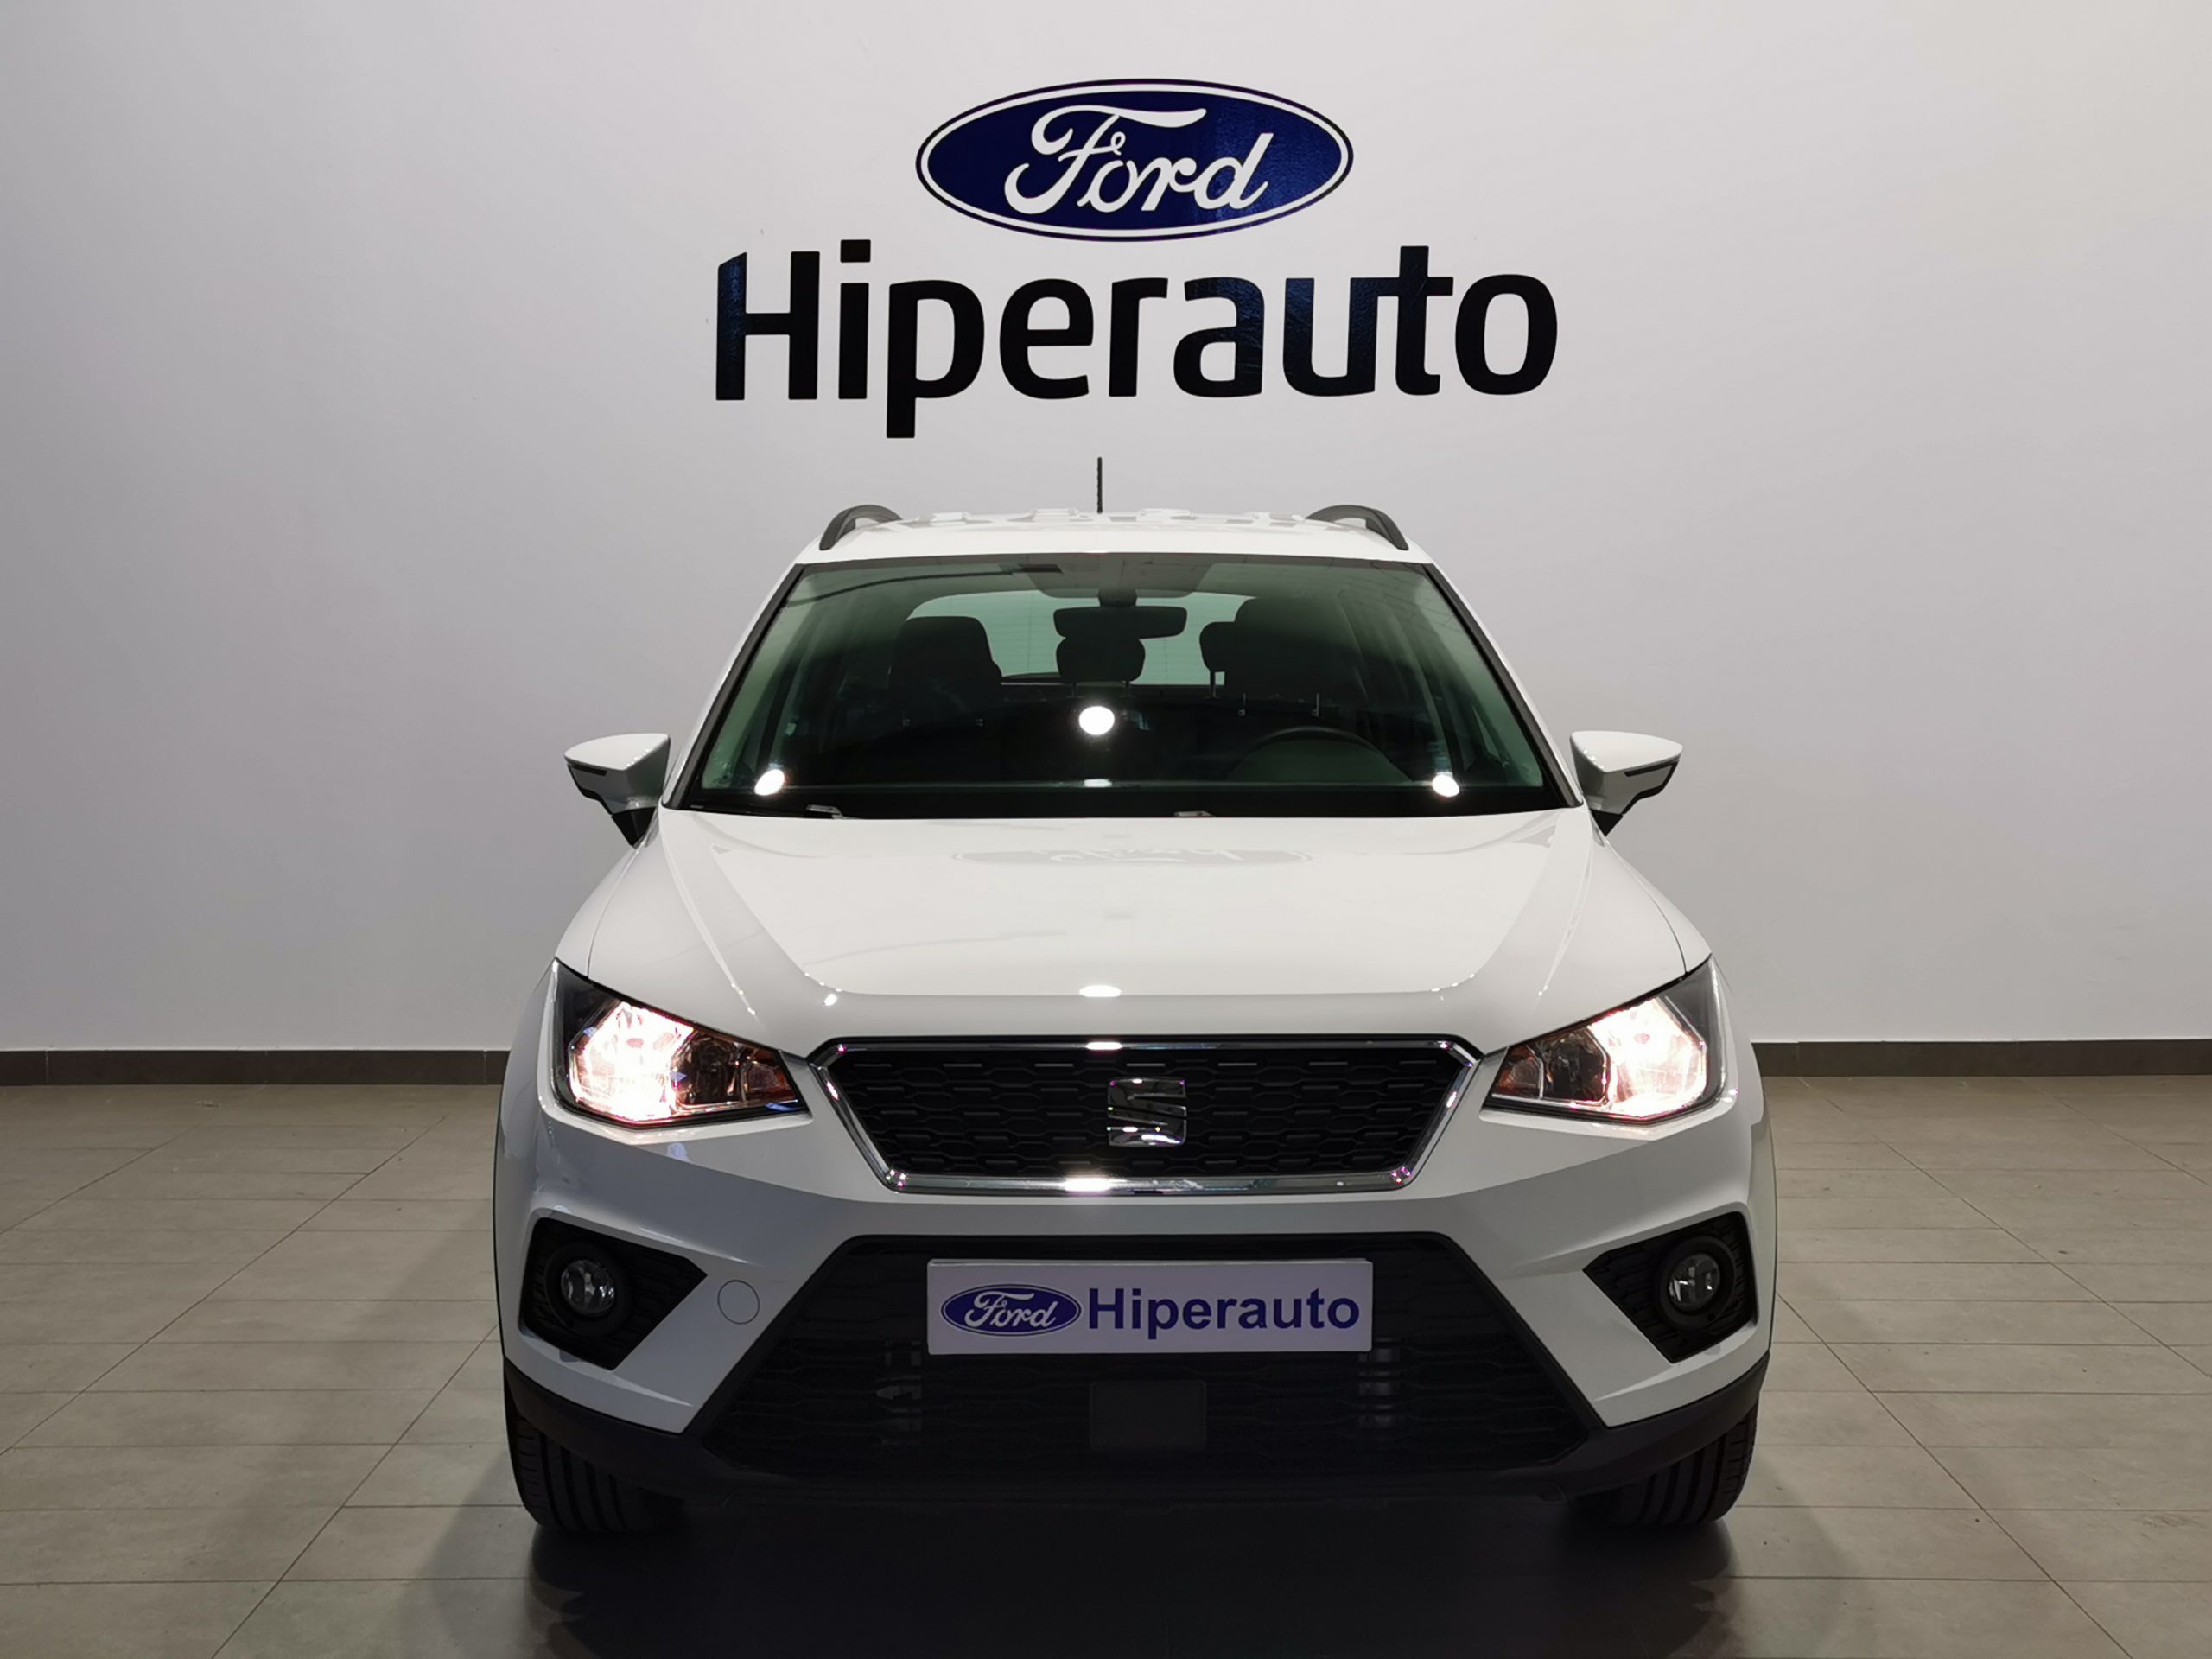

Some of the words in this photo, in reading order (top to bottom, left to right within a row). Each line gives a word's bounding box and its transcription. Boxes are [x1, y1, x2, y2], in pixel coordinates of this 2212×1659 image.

[1004, 105, 1274, 213] Ford
[715, 239, 1557, 438] Hiperauto
[963, 1290, 1057, 1329] Ford
[1089, 1287, 1360, 1339] Hiperauto
